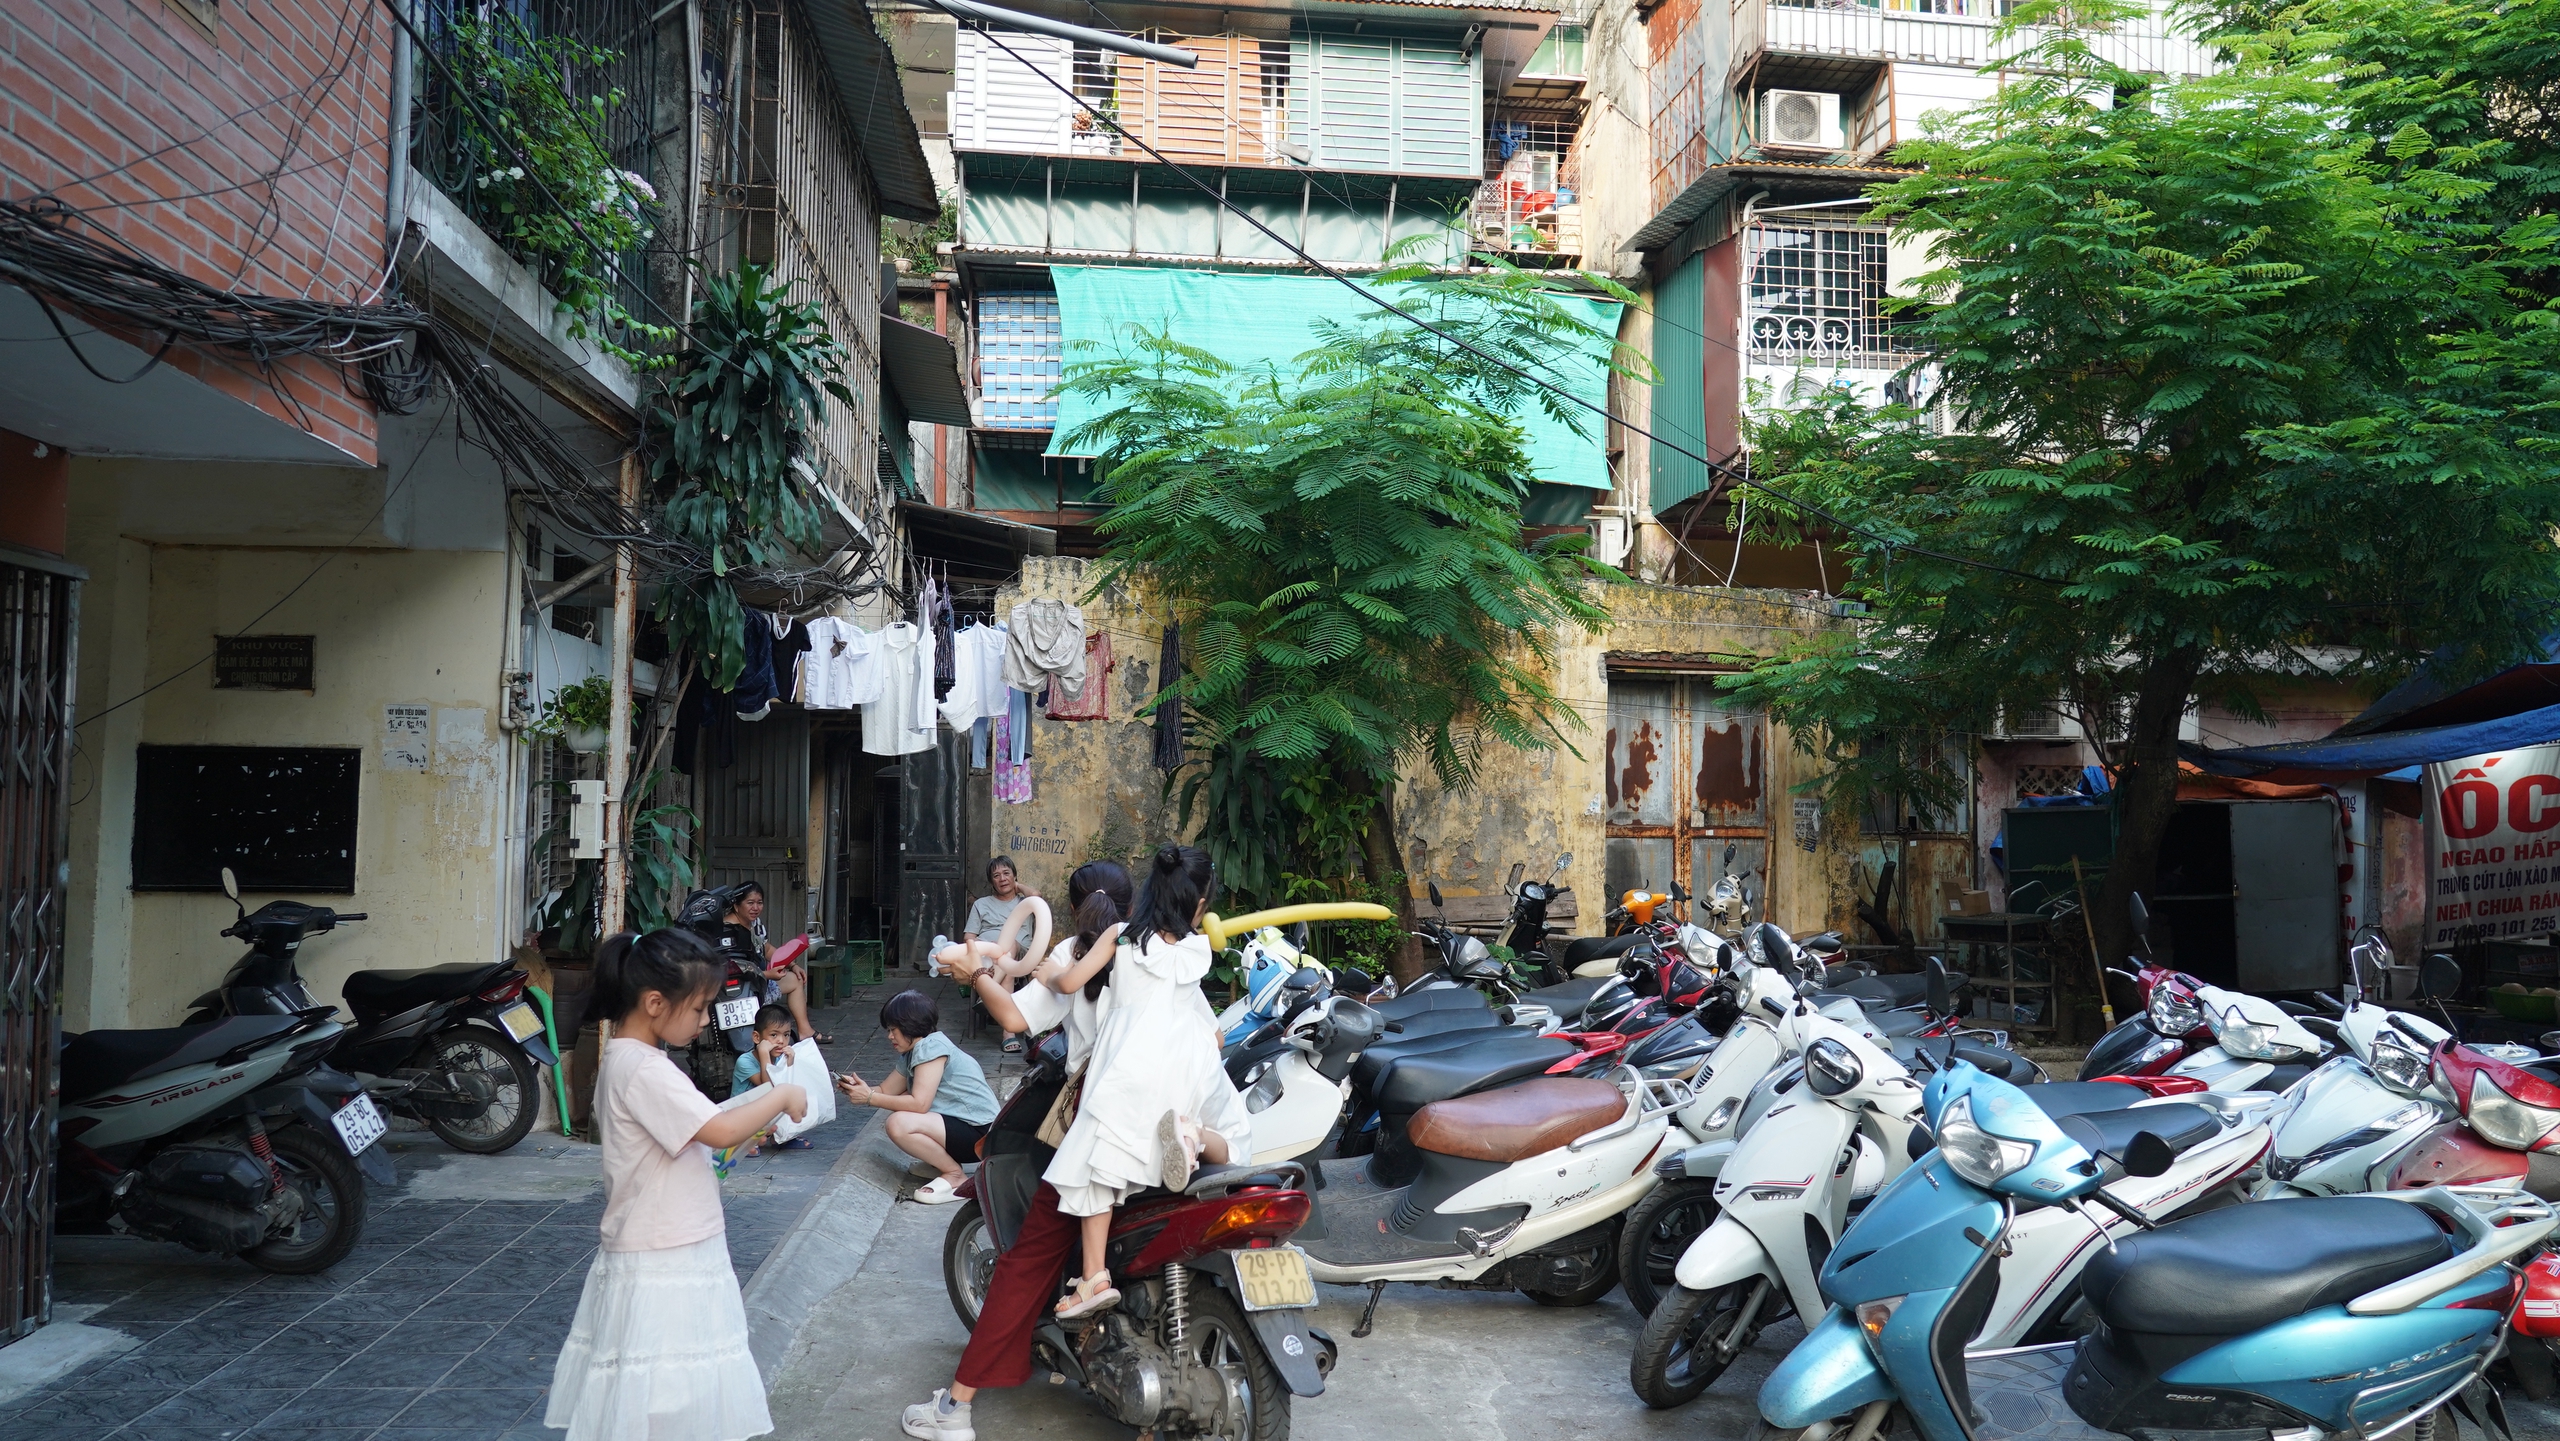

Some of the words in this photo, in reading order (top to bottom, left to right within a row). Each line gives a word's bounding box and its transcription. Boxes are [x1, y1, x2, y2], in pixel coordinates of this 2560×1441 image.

[232, 642, 263, 650] KHU
[250, 657, 261, 667] XE
[280, 657, 289, 667] XE
[2441, 757, 2560, 839] ỐC
[2442, 847, 2505, 868] NGAO
[2514, 836, 2560, 861] HẤP
[2474, 869, 2496, 891] CÚT
[2500, 868, 2521, 893] LỘN
[2525, 864, 2548, 886] XÀO
[2437, 902, 2471, 922] NEM
[2477, 896, 2524, 917] CHUA
[2529, 890, 2560, 911] RÁN
[2501, 919, 2526, 935] 101
[2531, 915, 2556, 931] 255
[722, 1000, 753, 1015] 30-L5
[339, 1099, 370, 1132] 29-BC
[346, 1116, 385, 1154] 054.42
[1244, 1252, 1299, 1278] 29-P1
